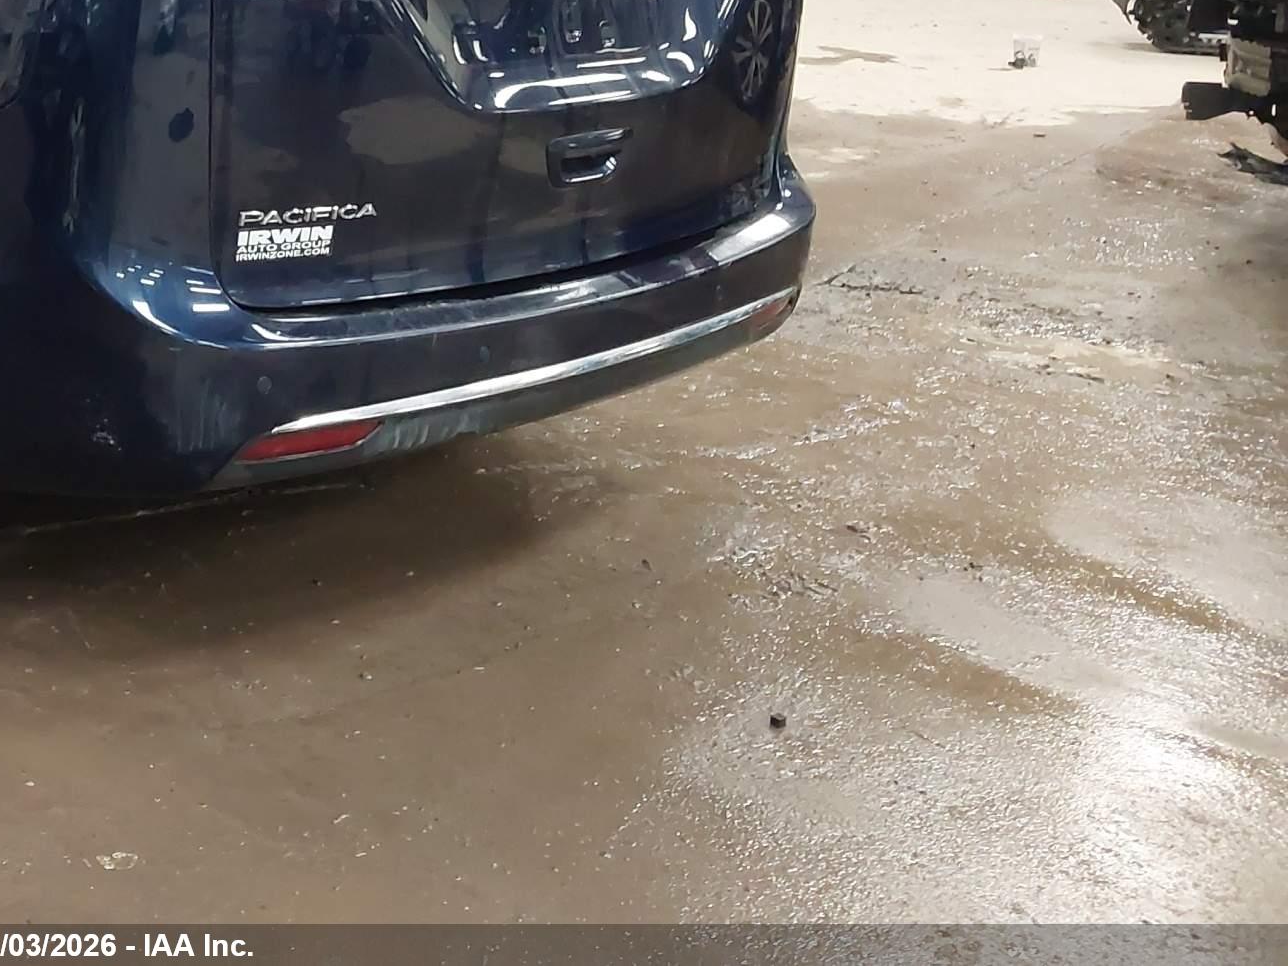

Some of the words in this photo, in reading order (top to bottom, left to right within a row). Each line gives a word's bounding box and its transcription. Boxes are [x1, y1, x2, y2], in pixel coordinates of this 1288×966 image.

[239, 203, 377, 226] PACIFICA
[237, 225, 334, 247] IRWIN
[236, 247, 330, 262] IRWINZONE.COM
[237, 244, 278, 254] AUTO
[280, 239, 331, 251] GROUP
